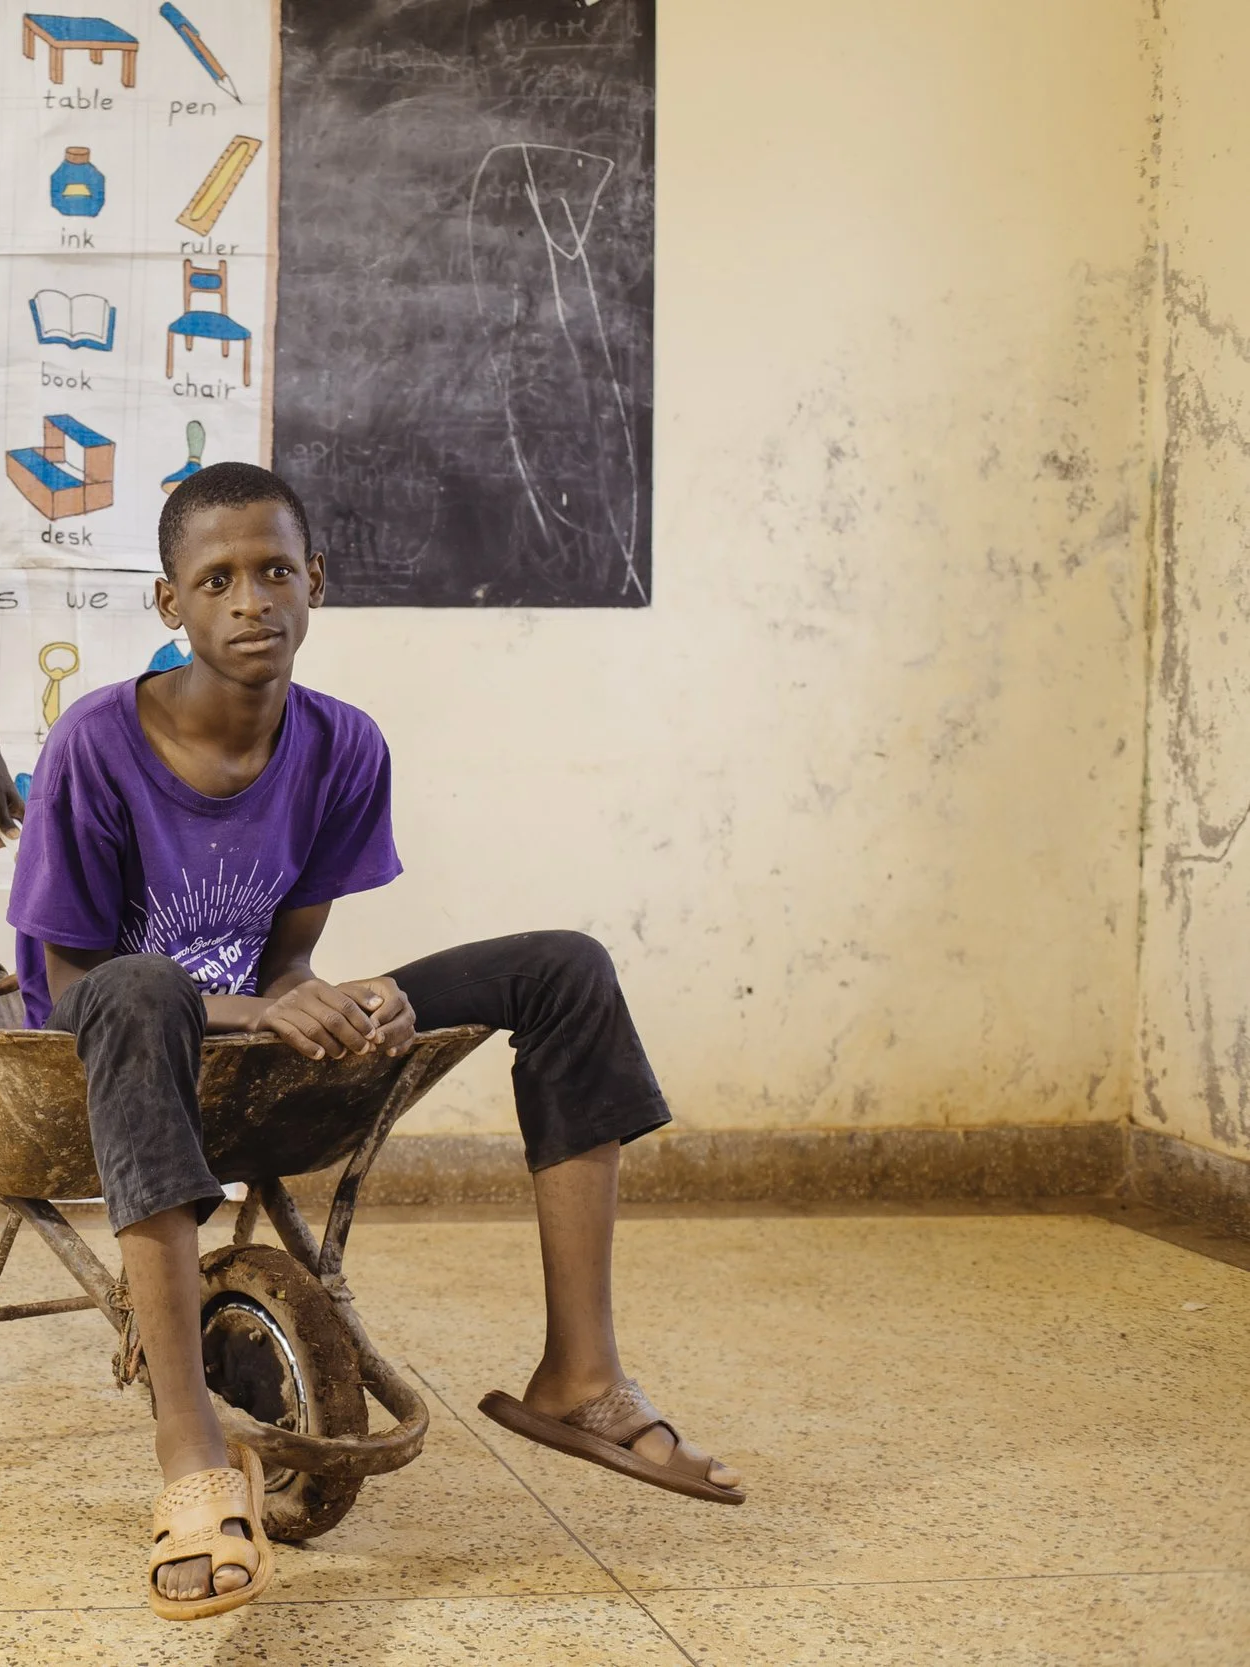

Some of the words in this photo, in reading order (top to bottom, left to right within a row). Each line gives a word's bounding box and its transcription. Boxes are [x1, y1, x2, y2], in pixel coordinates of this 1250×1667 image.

[44, 88, 114, 111] table
[169, 100, 217, 126] pen
[60, 227, 95, 249] ink
[179, 236, 240, 257] ruler
[40, 361, 94, 391] book
[172, 373, 236, 399] chair
[40, 523, 94, 547] desk
[66, 589, 109, 610] we
[218, 938, 243, 969] for
